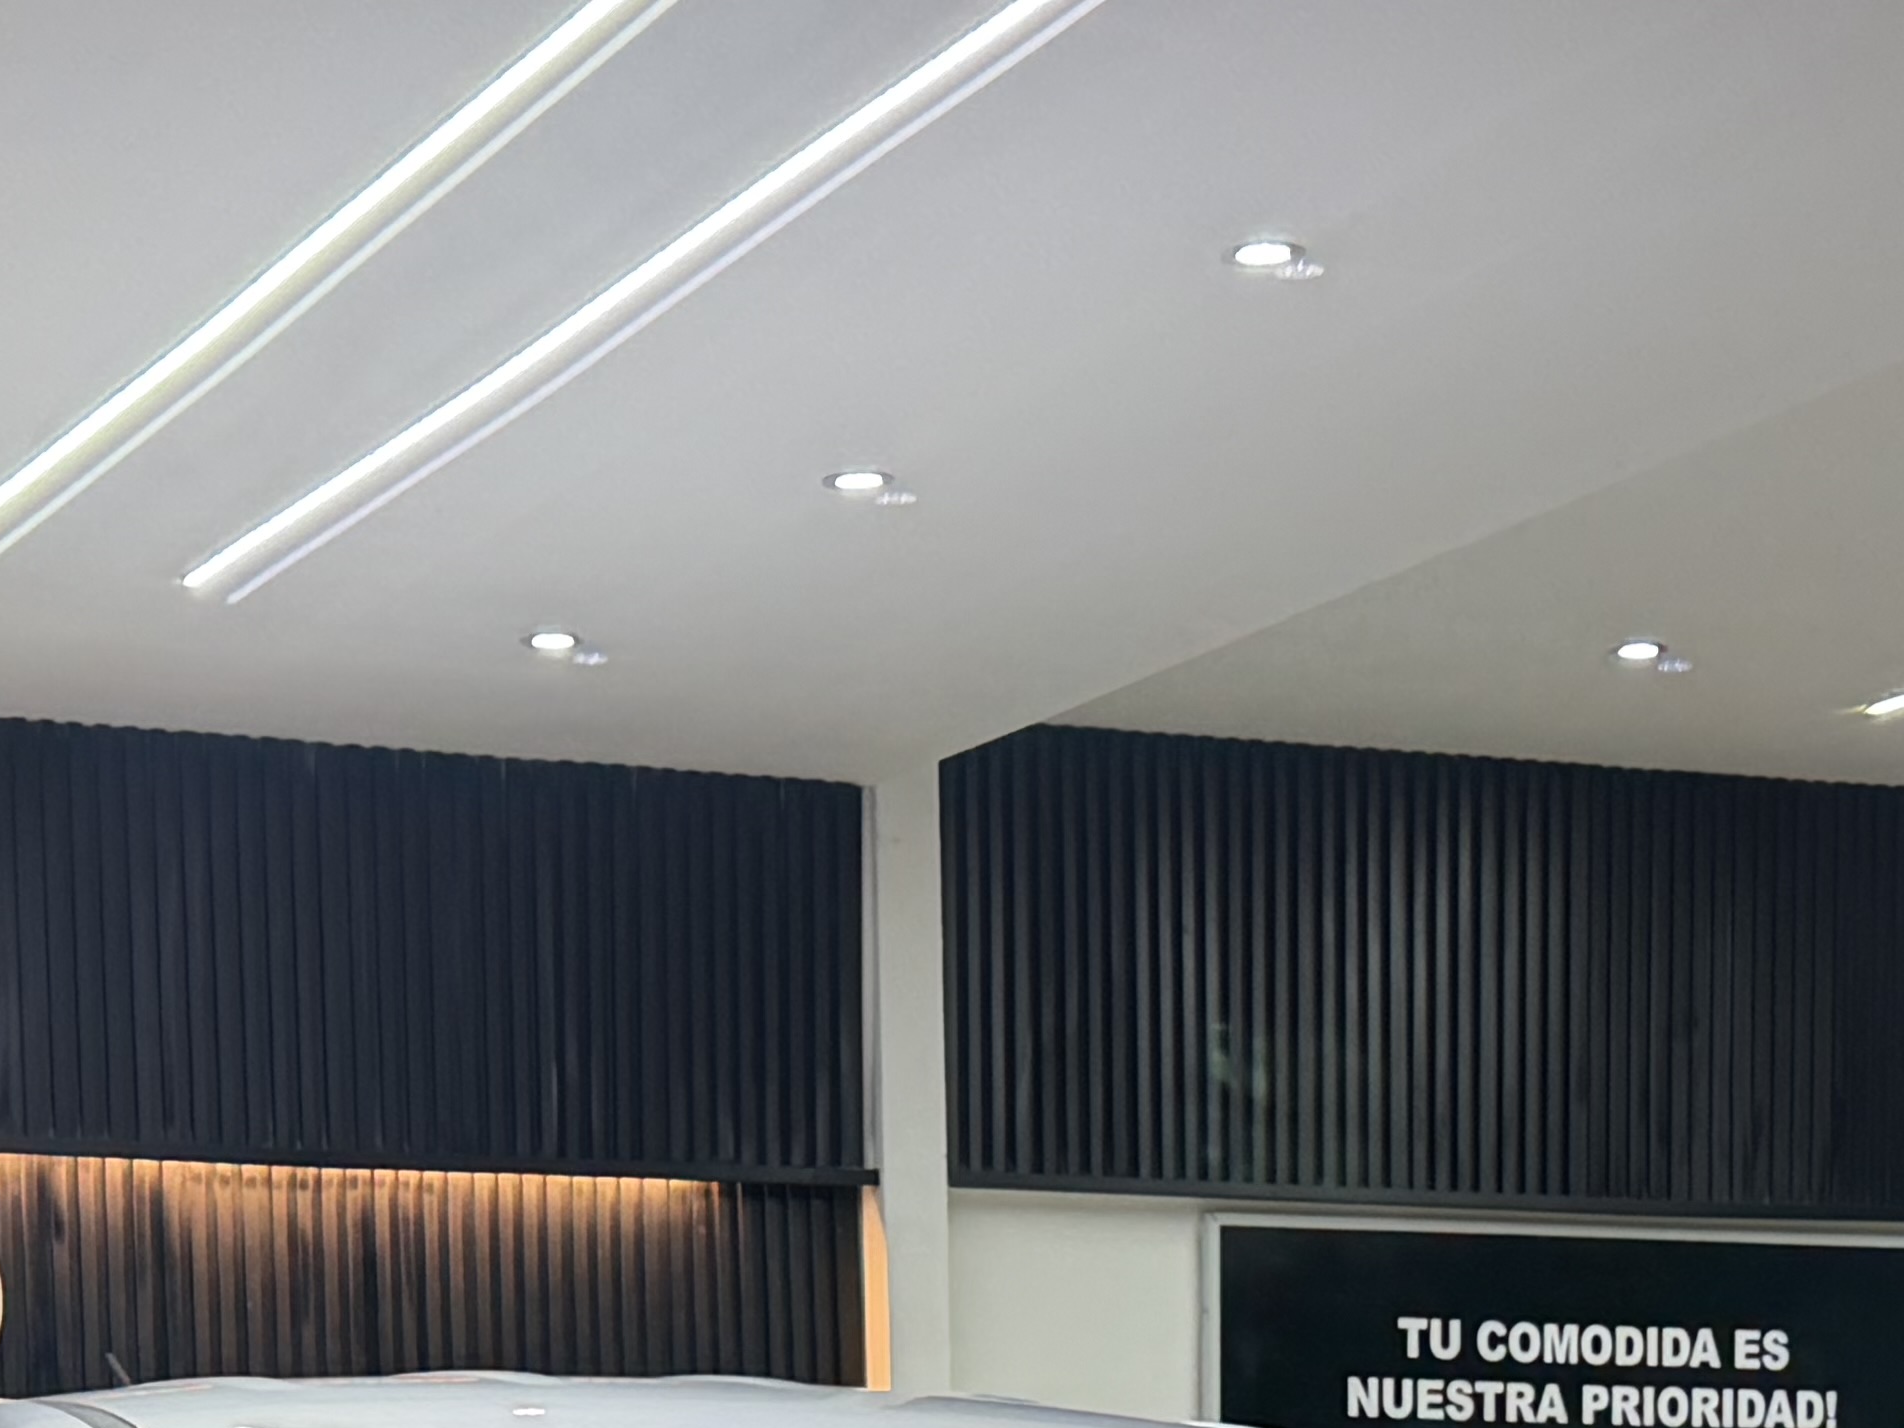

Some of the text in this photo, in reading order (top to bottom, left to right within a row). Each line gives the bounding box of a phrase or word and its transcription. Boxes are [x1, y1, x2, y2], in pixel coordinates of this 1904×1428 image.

[1398, 1317, 1790, 1370] TU COMODIDA ES
[1346, 1376, 1567, 1425] NUESTRA
